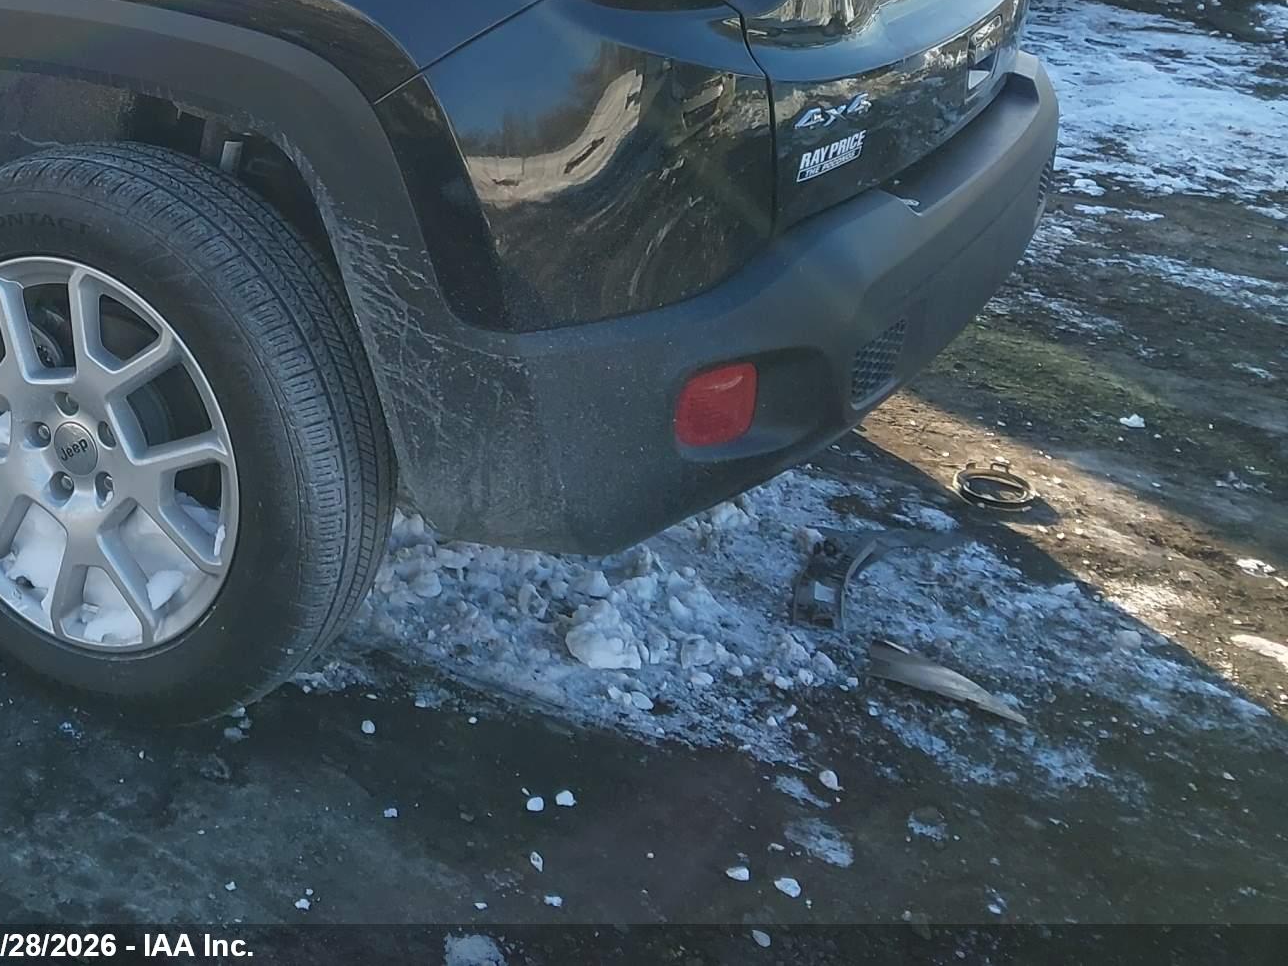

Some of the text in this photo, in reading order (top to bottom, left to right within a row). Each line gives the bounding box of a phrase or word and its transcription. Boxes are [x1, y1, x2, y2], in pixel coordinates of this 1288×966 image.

[800, 130, 867, 170] RAY PRICE
[805, 164, 821, 178] THE
[60, 438, 89, 462] Jeep
